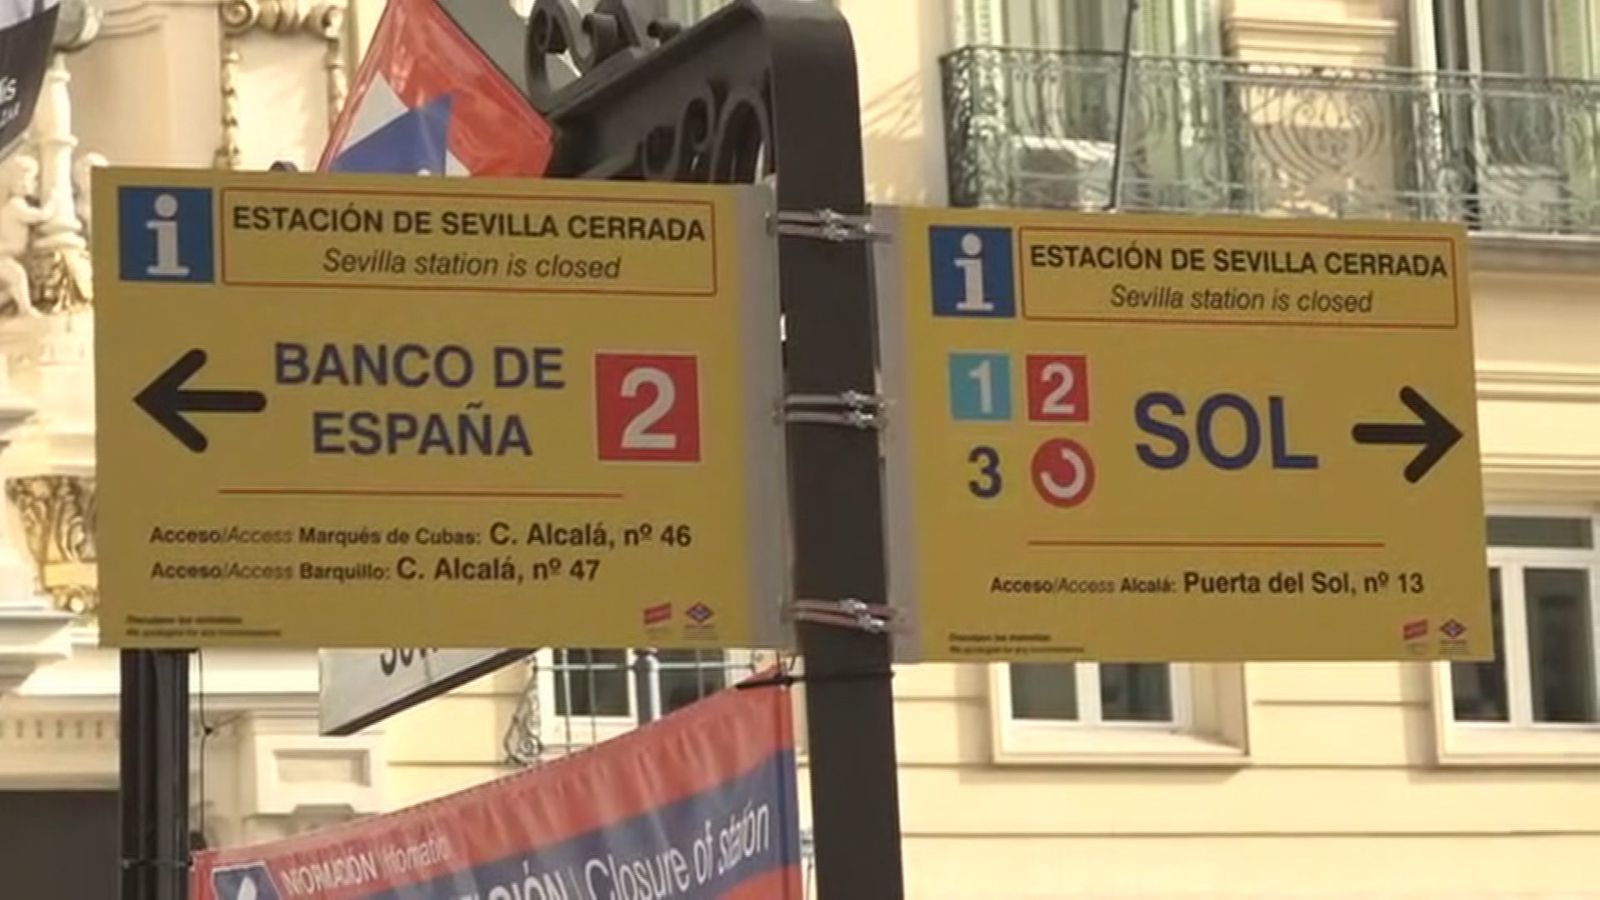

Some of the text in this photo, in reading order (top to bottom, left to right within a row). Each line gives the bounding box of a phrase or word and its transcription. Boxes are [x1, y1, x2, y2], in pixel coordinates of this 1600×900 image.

[233, 203, 705, 241] ESTACIÓN DE SEVILLA CERRADA
[323, 248, 621, 279] Sevilla station is closed
[1031, 241, 1447, 277] ESTACIÓN DE SEVILLA CERRADA
[1111, 284, 1373, 313] Sevilla station is closed
[275, 342, 565, 389] BANCO DE
[621, 368, 676, 448] 2
[967, 360, 1074, 414] 1 2
[313, 402, 533, 456] ESPAÑA
[1135, 392, 1318, 470] SOL
[968, 446, 1001, 498] 3
[299, 527, 381, 548] Marqués
[386, 527, 410, 544] de
[415, 527, 480, 545] Cubas:
[490, 522, 517, 545] C.
[527, 522, 614, 549] Alcalá,
[660, 525, 691, 547] 46
[300, 562, 389, 583] Barquillo:
[397, 557, 424, 580] C.
[434, 556, 523, 583] Alcalá,
[570, 559, 600, 580] 47
[1120, 578, 1176, 593] Alcalá:
[1184, 572, 1260, 593] Puerta
[1268, 572, 1303, 593] del
[1312, 571, 1356, 595] Sol,
[1398, 573, 1424, 593] 13
[585, 848, 690, 900] Closure
[694, 819, 713, 884] of
